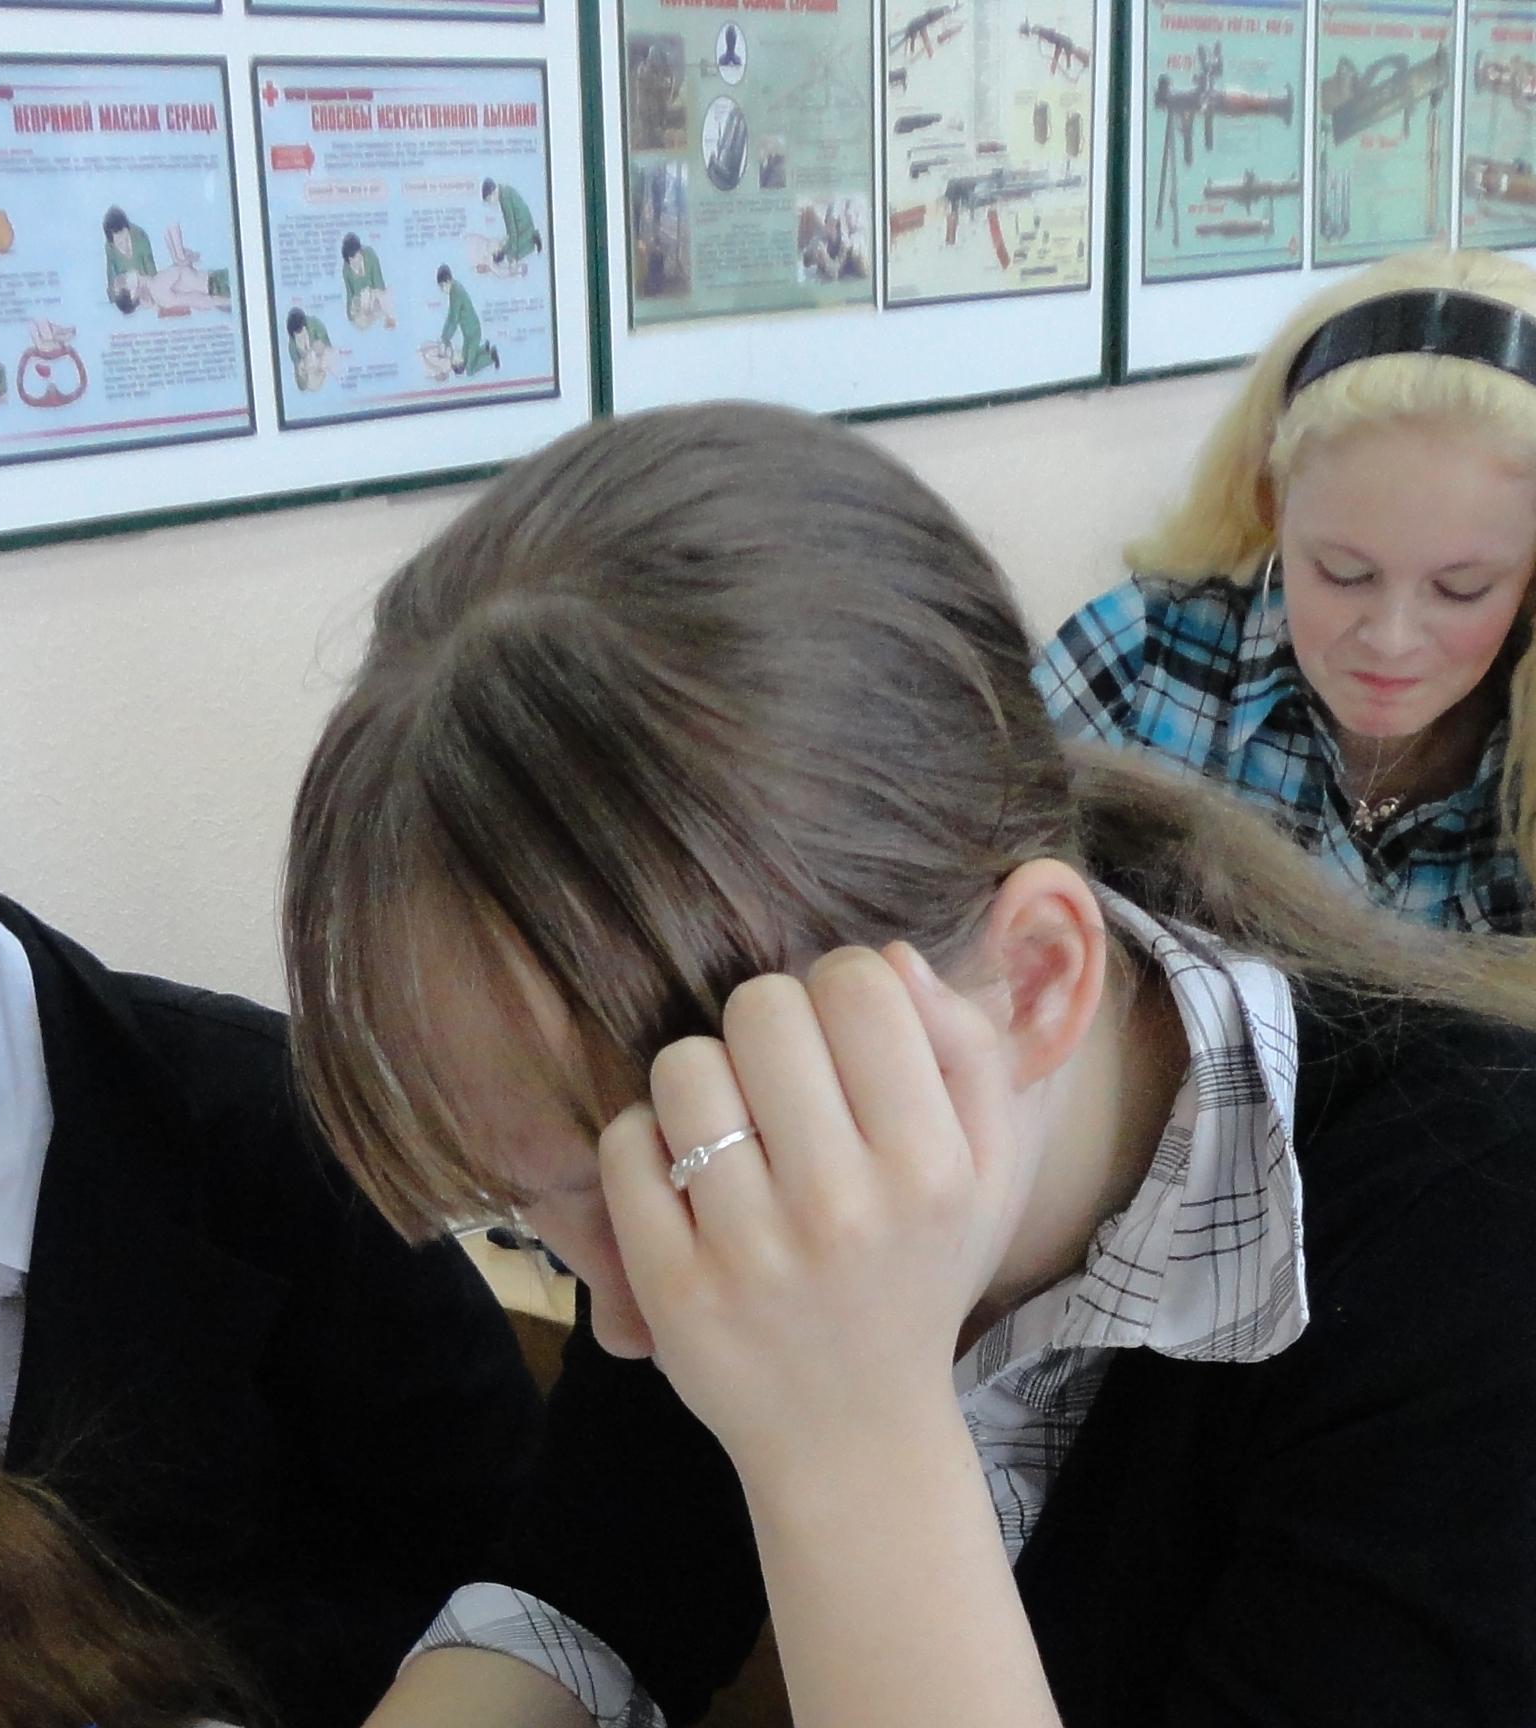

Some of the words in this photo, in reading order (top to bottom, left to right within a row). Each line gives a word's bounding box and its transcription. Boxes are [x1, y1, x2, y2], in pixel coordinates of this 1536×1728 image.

[14, 101, 94, 133] НЕПРЯМОЙ
[98, 103, 161, 132] МАССАЖ
[166, 103, 218, 134] СЕРДЦА
[311, 103, 372, 131] СПОСОБЫ
[377, 103, 479, 130] ИСКУССТВЕННОГО
[483, 102, 537, 128] ДЫХАНИЯ
